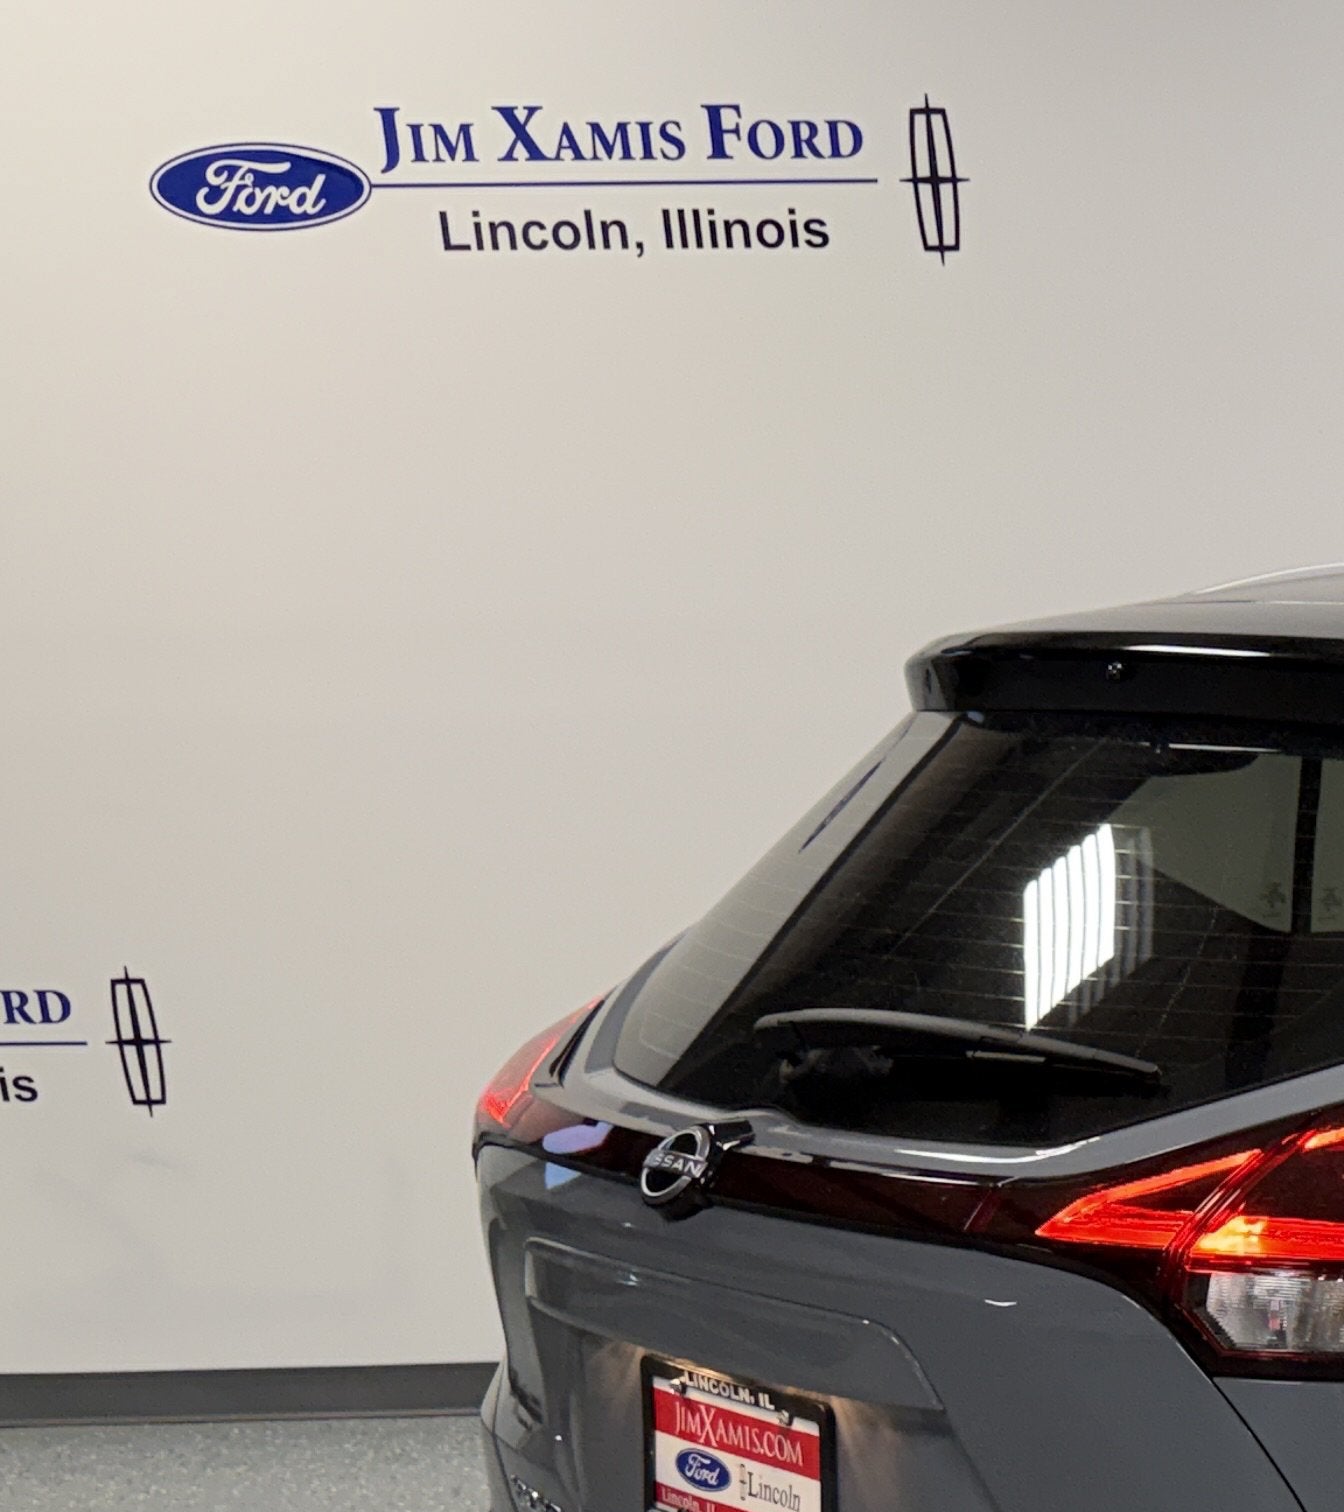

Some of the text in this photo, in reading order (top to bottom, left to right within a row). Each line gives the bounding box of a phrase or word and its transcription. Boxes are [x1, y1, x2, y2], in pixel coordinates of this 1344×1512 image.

[373, 103, 863, 174] JIM XAMIS FORD
[196, 160, 327, 215] Ford
[439, 207, 830, 258] Lincoln, Illinois
[758, 1392, 775, 1410] IL
[675, 1401, 803, 1467] JIMXAMIS.COM
[685, 1453, 720, 1485] Ford
[747, 1471, 801, 1512] Lincoln
